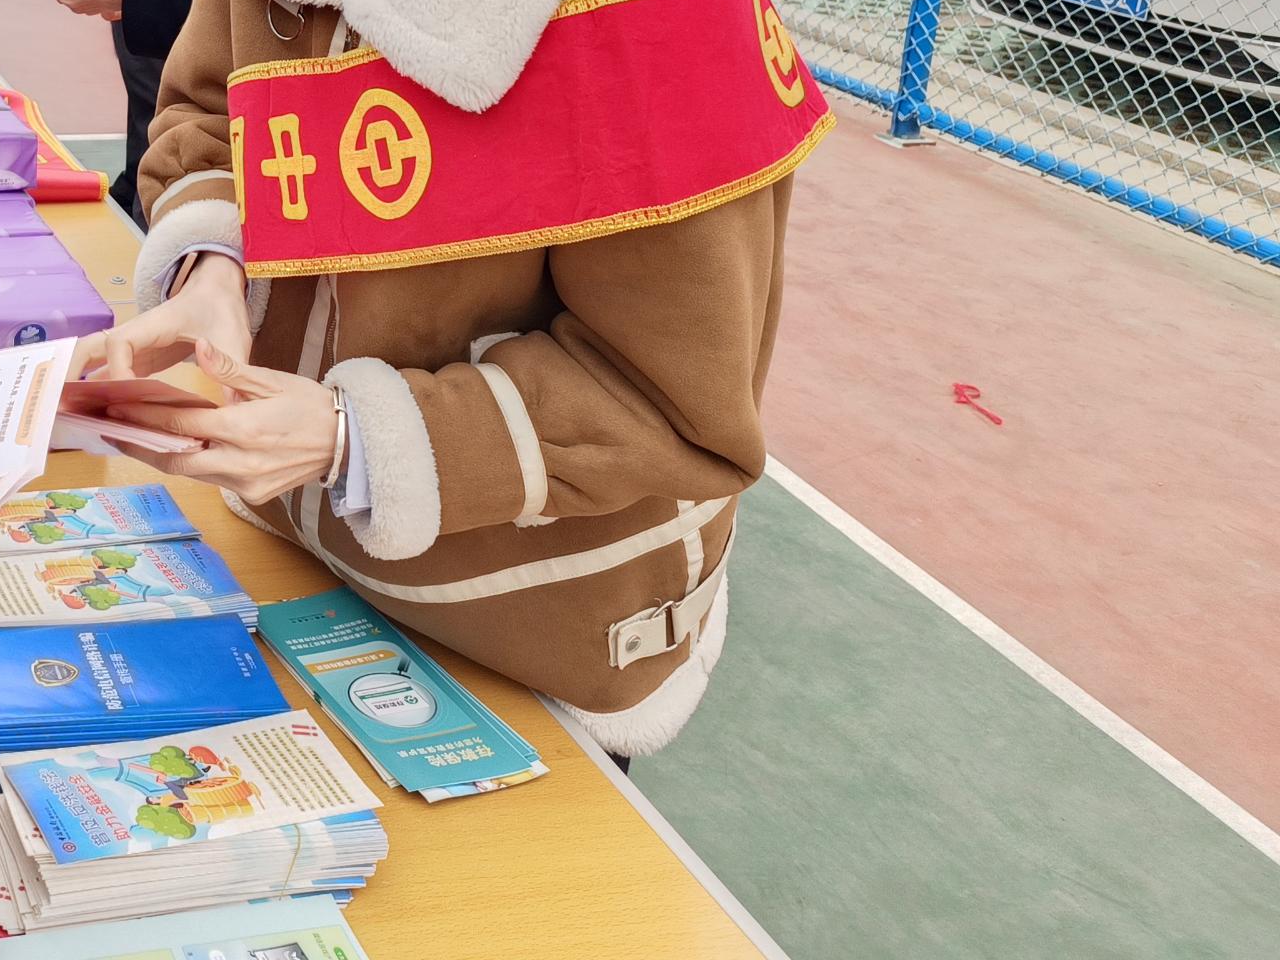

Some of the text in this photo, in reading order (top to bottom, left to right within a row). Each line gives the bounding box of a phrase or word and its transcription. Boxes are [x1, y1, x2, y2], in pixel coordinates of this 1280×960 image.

[78, 632, 125, 711] 防范电信网络诈骗
[425, 744, 496, 769] 存款保险
